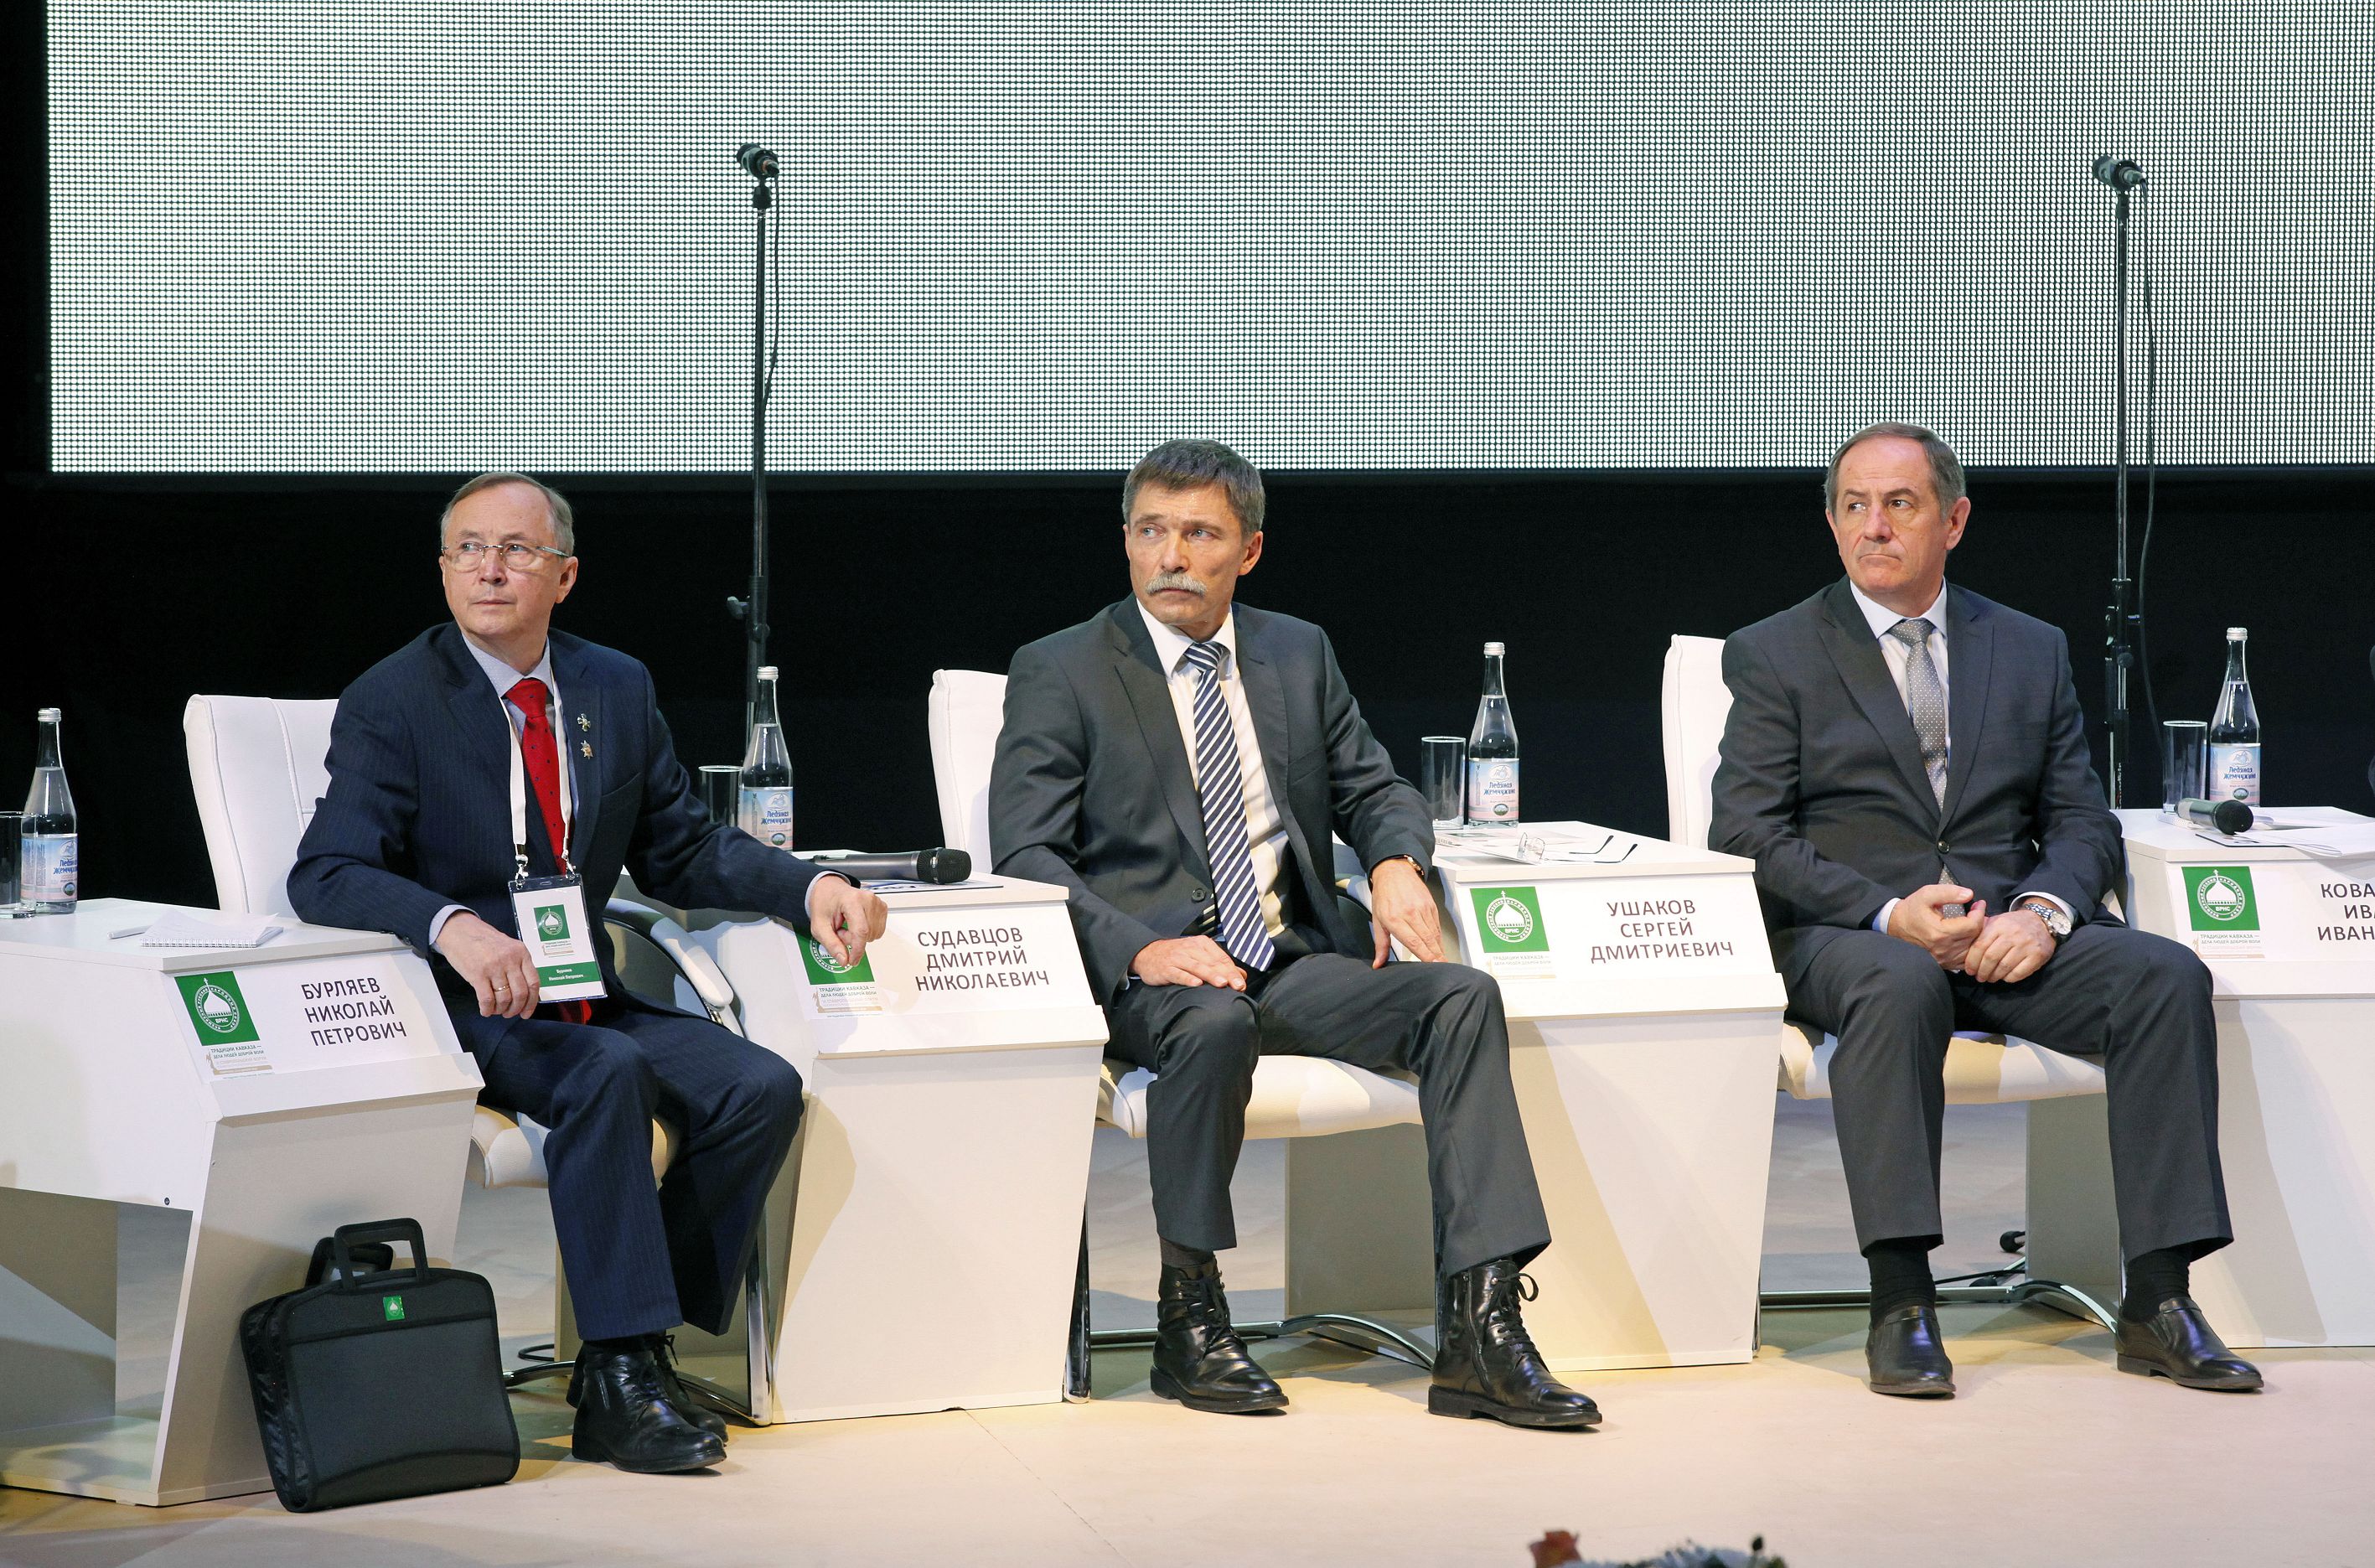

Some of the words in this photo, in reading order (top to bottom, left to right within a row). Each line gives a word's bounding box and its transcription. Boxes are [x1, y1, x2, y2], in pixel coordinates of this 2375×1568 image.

[2321, 883, 2375, 898] КОВА
[1607, 899, 1696, 917] УШАКОВ
[2344, 904, 2375, 919] ИВ
[918, 927, 1023, 950] СУДАВЦОВ
[1620, 917, 1693, 938] СЕРГЕЙ
[2317, 925, 2375, 941] ИВАН
[926, 945, 1027, 972] ДМИТРИЙ
[1591, 941, 1734, 965] ДМИТРИЕВИЧ
[301, 977, 380, 1000] БУРЛЯЕВ
[914, 970, 1049, 991] НИКОЛАЕВИЧ
[304, 996, 395, 1023] НИКОЛАЙ
[310, 1021, 407, 1047] ПЕТРОВИЧ
